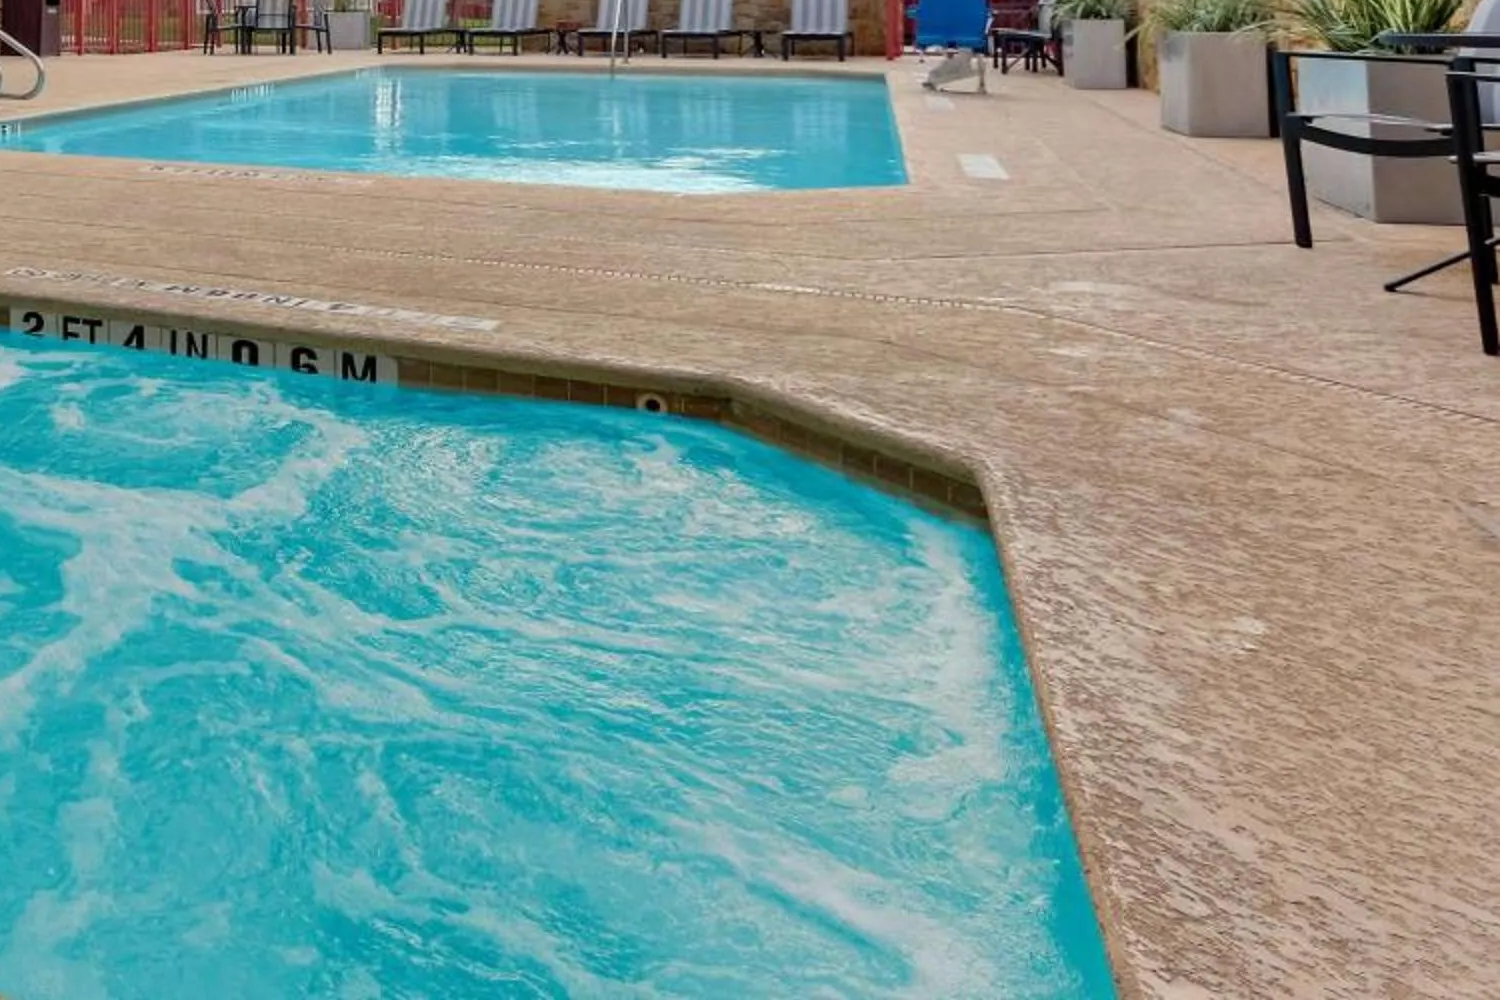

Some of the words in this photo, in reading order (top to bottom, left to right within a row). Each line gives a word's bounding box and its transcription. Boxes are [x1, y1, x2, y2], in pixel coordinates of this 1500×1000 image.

[22, 311, 45, 337] 2
[62, 315, 103, 345] FT
[122, 325, 145, 350] 4
[170, 329, 208, 359] IN
[341, 351, 377, 384] M
